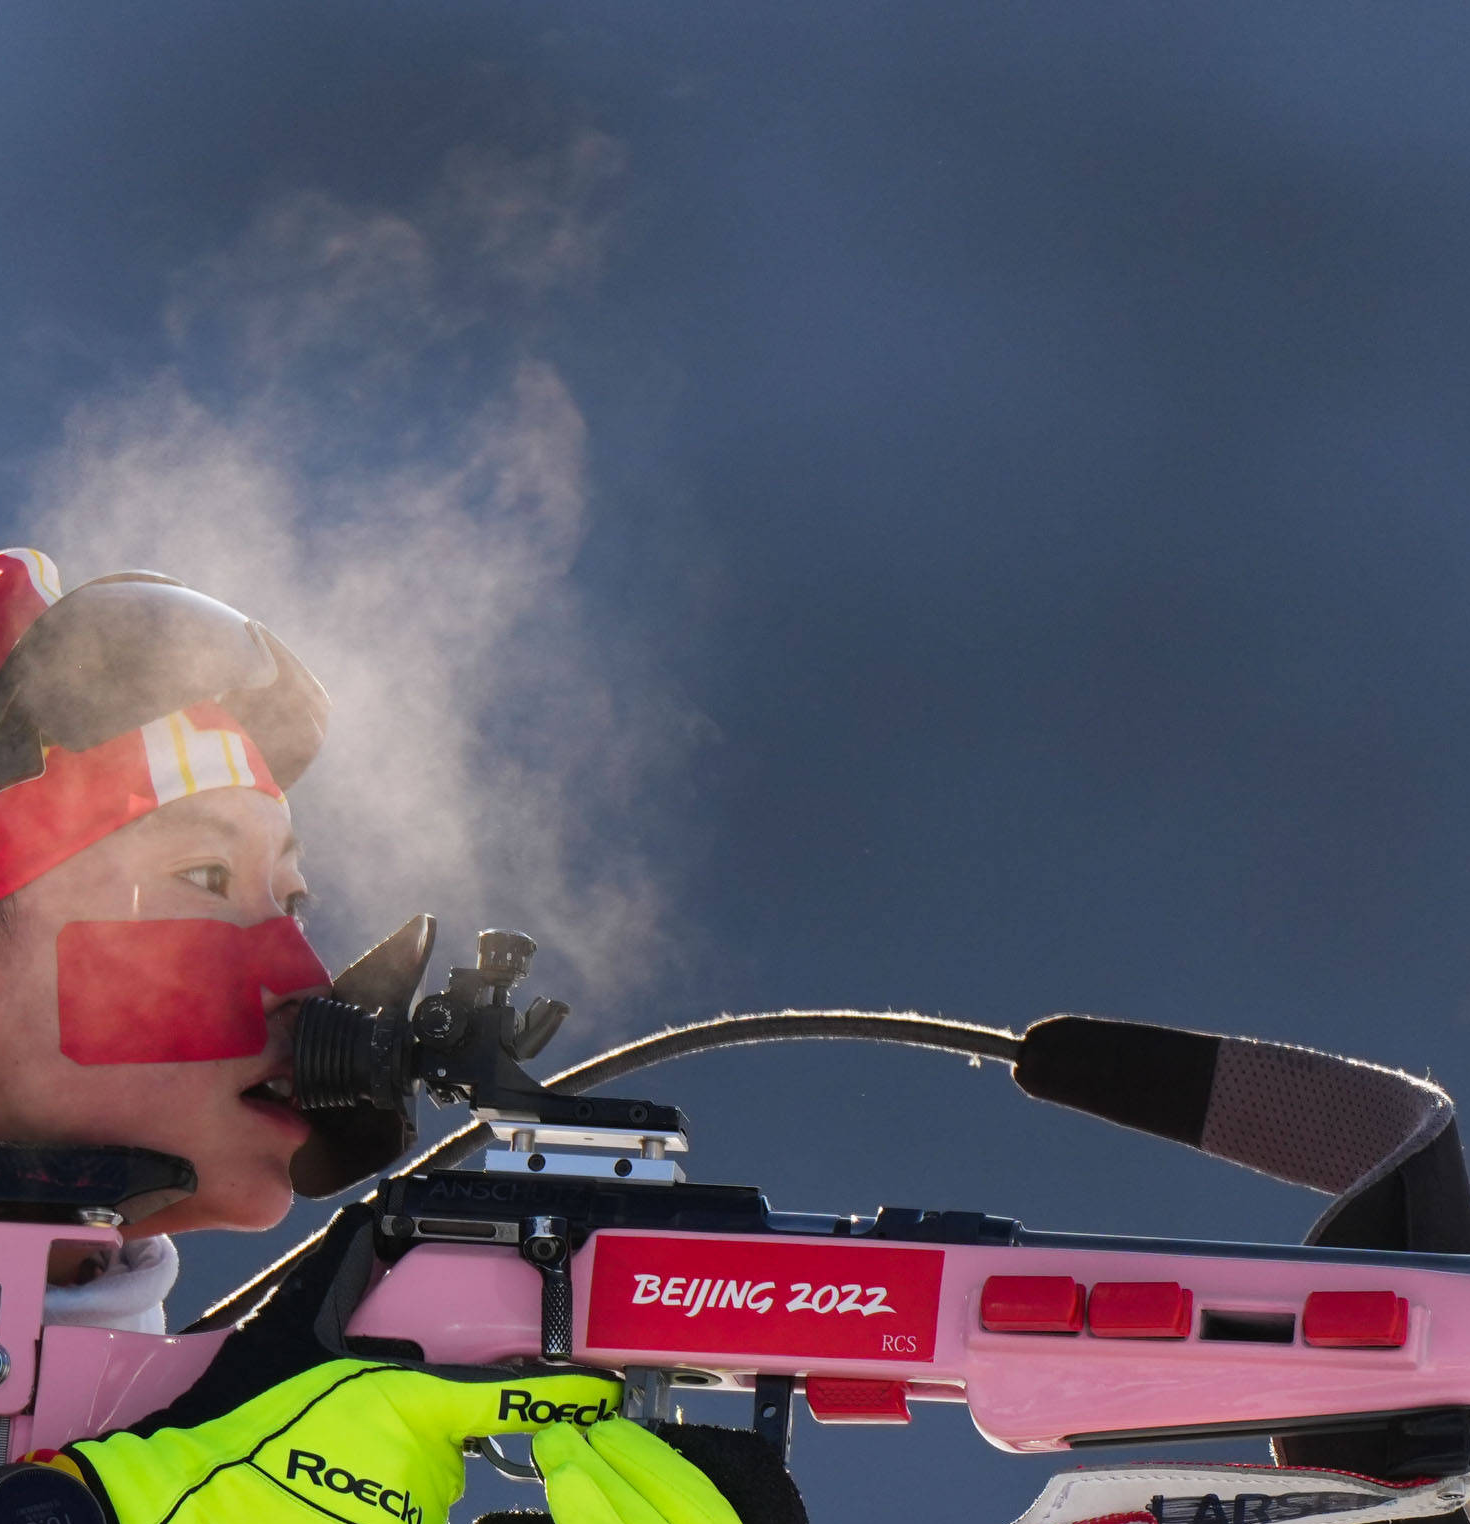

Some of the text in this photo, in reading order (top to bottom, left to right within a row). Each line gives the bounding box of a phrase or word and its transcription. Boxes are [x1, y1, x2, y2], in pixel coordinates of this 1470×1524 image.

[632, 1274, 898, 1318] BEIJING 2022
[882, 1334, 917, 1354] RCS
[497, 1388, 620, 1427] Roeck
